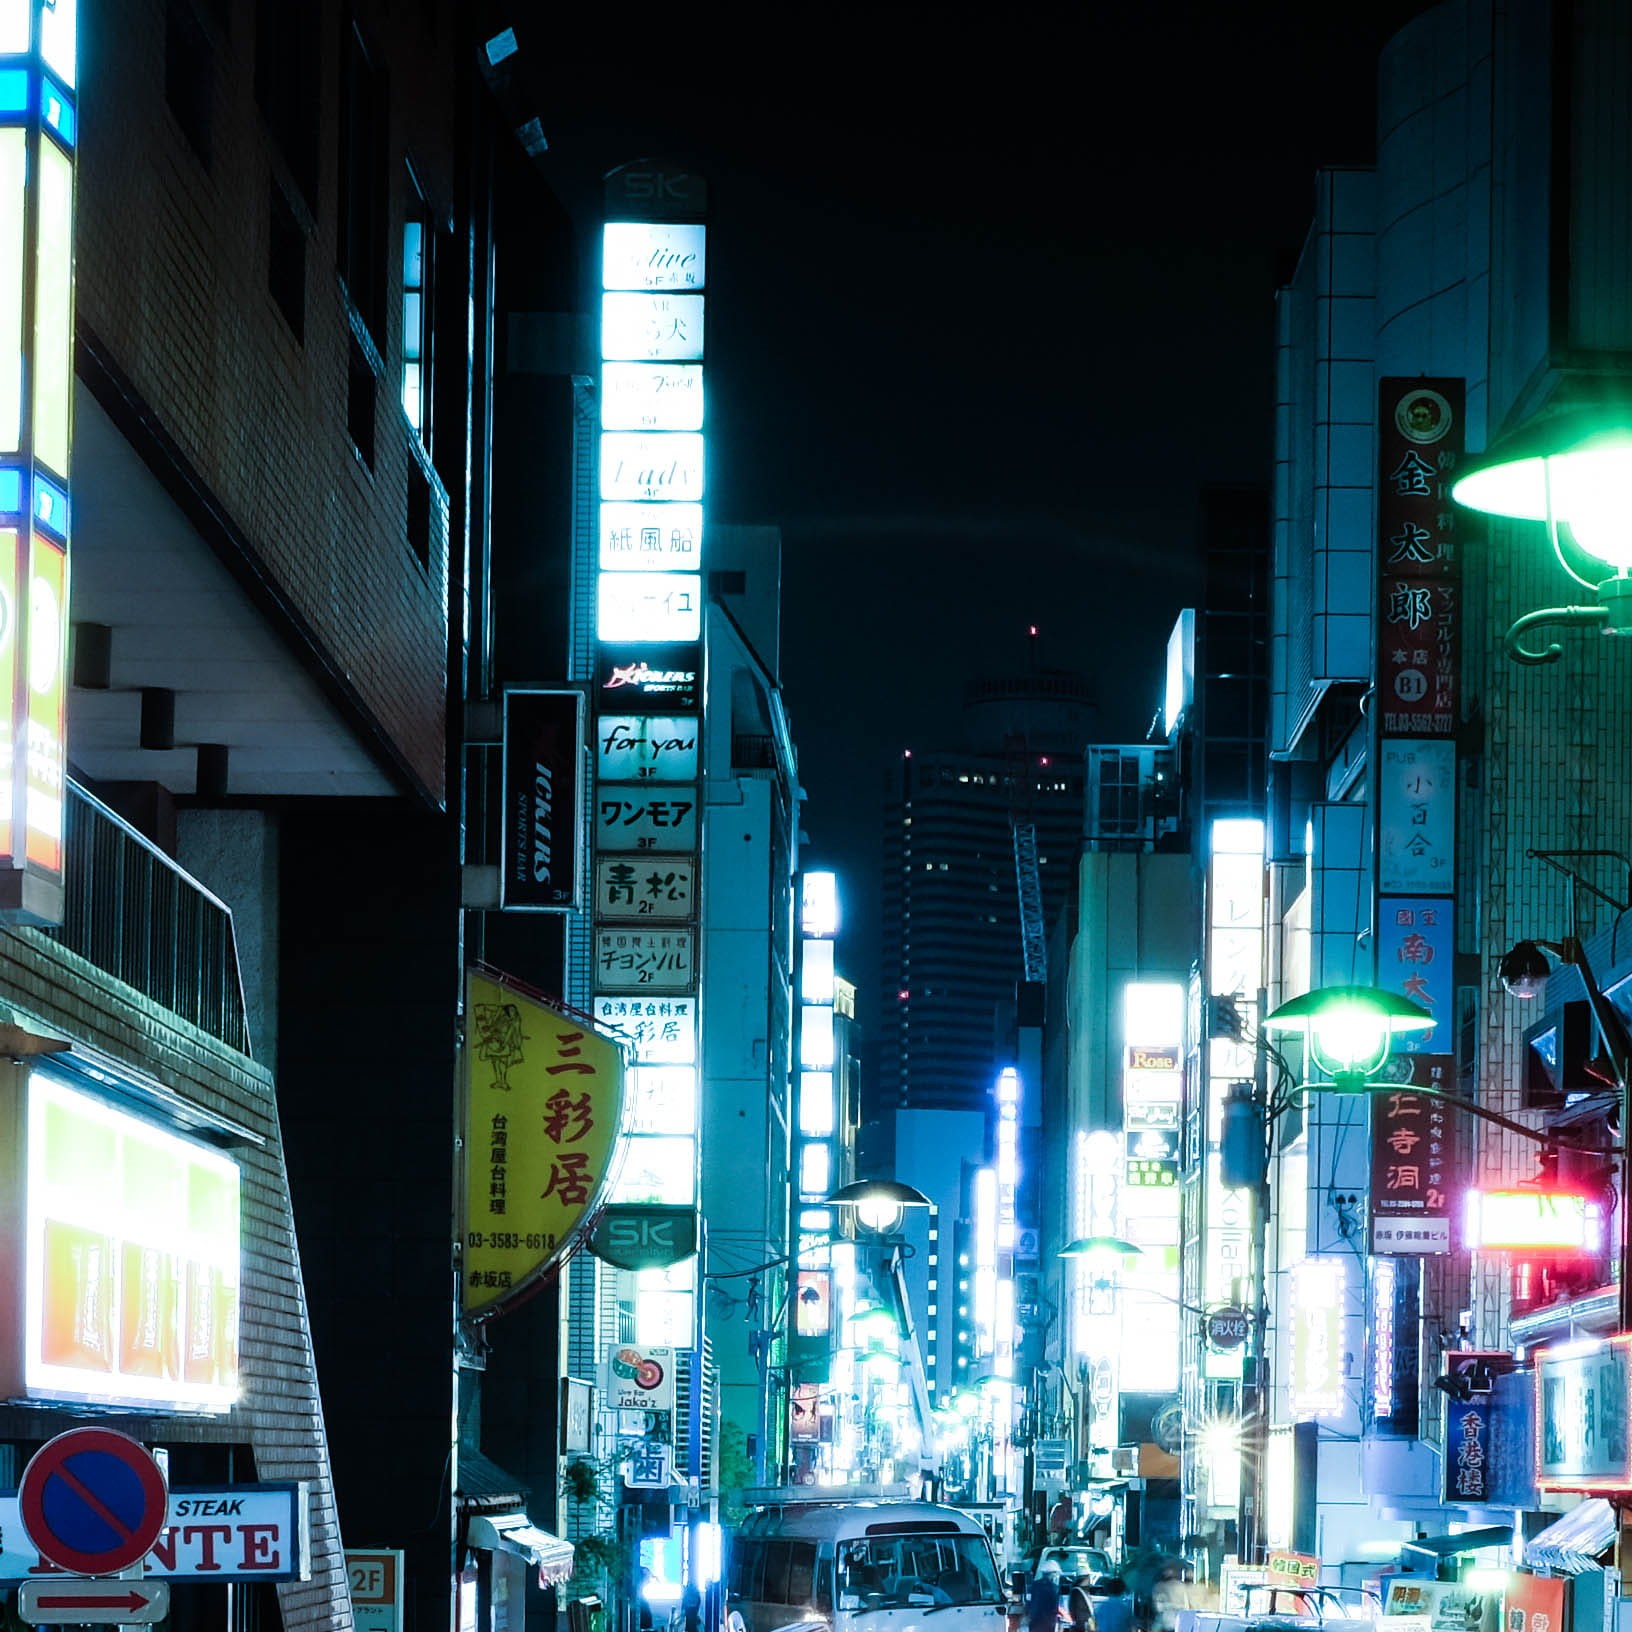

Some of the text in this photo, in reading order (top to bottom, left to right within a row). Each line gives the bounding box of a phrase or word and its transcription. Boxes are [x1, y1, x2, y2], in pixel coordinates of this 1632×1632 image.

[610, 528, 694, 552] 紙風船
[1389, 449, 1436, 631] 金太郎
[1391, 649, 1428, 665] 本店
[1400, 677, 1424, 696] B1
[602, 725, 694, 760] for you
[639, 767, 657, 777] 3F
[601, 801, 692, 827] ワンモア
[1406, 776, 1432, 856] 小百合
[637, 838, 657, 848] 3F
[1430, 858, 1446, 870] 3F
[606, 864, 688, 905] 青松
[639, 901, 655, 914] 2F
[638, 970, 655, 983] 2F
[601, 1002, 688, 1017] 台湾屋台料理
[1134, 1051, 1173, 1069] Rose
[541, 1032, 595, 1206] 三彩居
[1387, 1093, 1420, 1190] 仁寺洞
[490, 1114, 508, 1215] 台湾屋台料理
[1427, 1189, 1445, 1208] 2F
[468, 1233, 555, 1250] 03-3583-6618
[609, 1219, 675, 1247] SK
[469, 1271, 512, 1289] 赤坂店
[1212, 1321, 1246, 1336] 消火栓
[175, 1499, 245, 1517] STEAK
[1273, 1559, 1316, 1578] 韓国式
[352, 1569, 380, 1591] 2F
